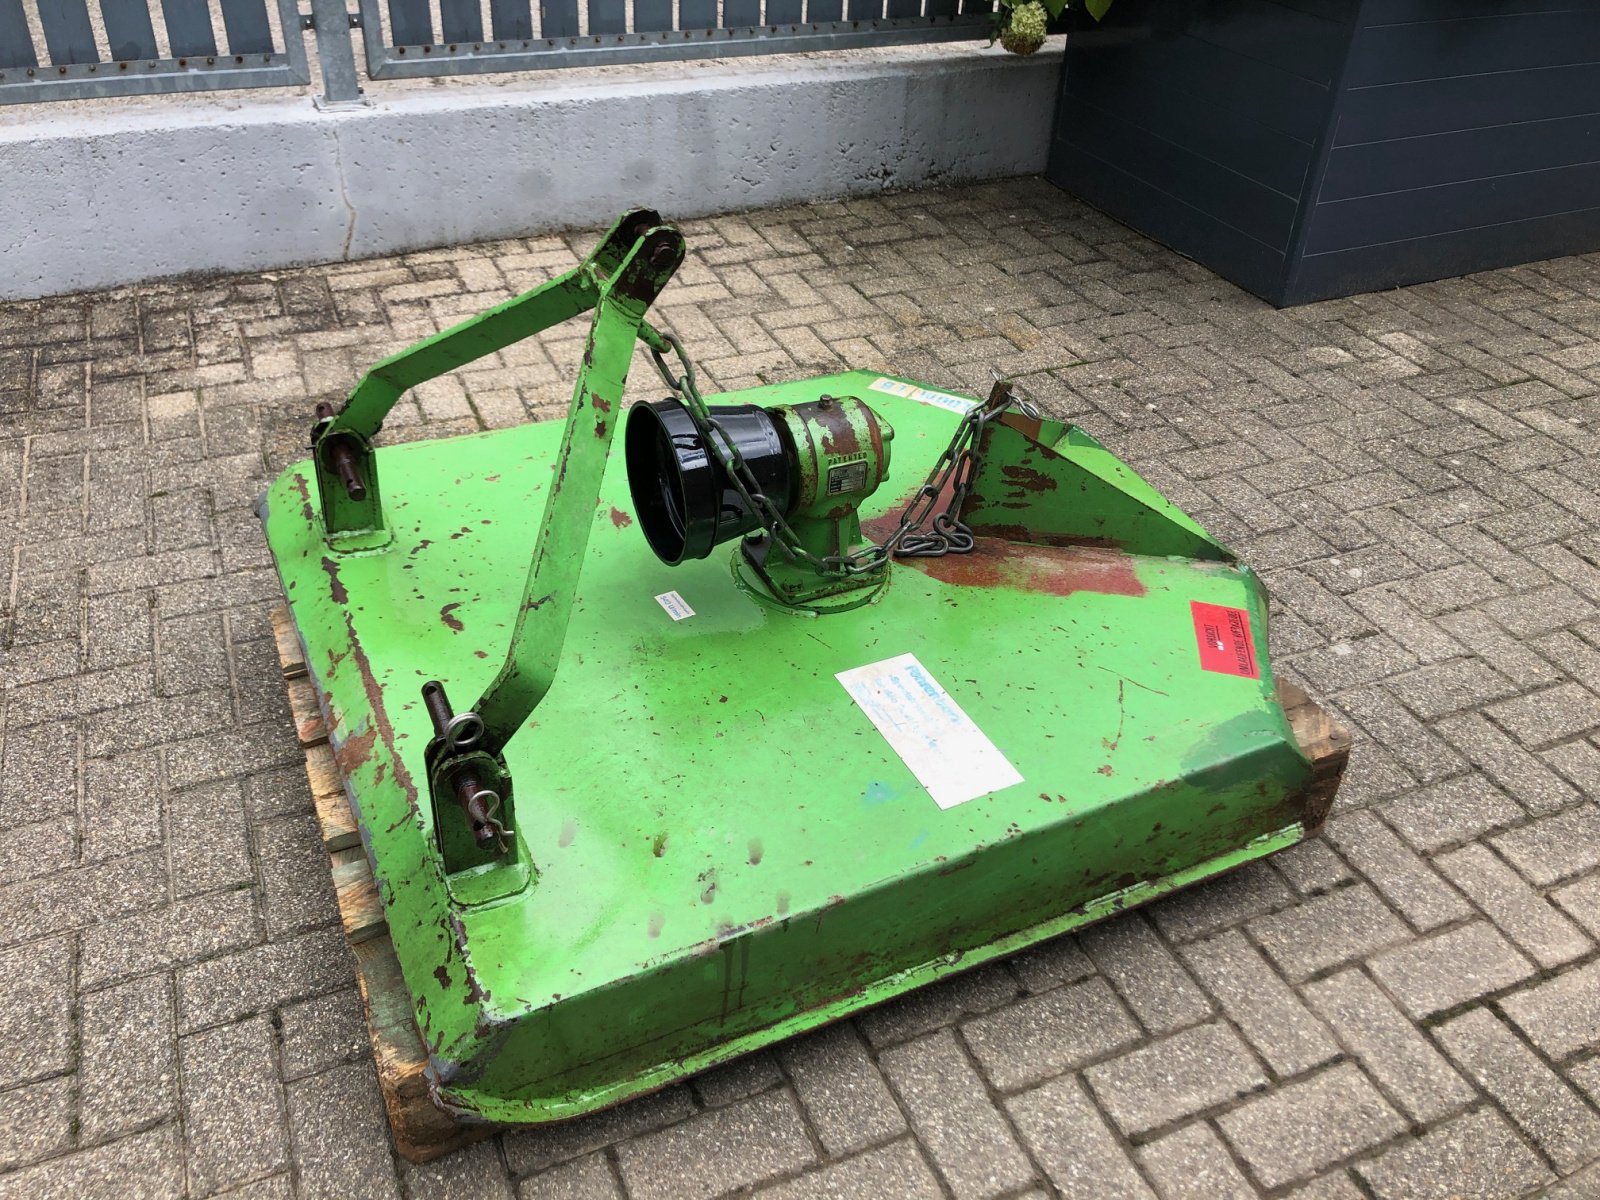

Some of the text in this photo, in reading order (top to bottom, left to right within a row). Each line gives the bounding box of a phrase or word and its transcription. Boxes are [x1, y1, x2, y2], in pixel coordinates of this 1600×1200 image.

[828, 451, 868, 466] PATENTED
[1204, 623, 1218, 649] VORSICHT
[1233, 639, 1251, 675] UMLAUFENDE
